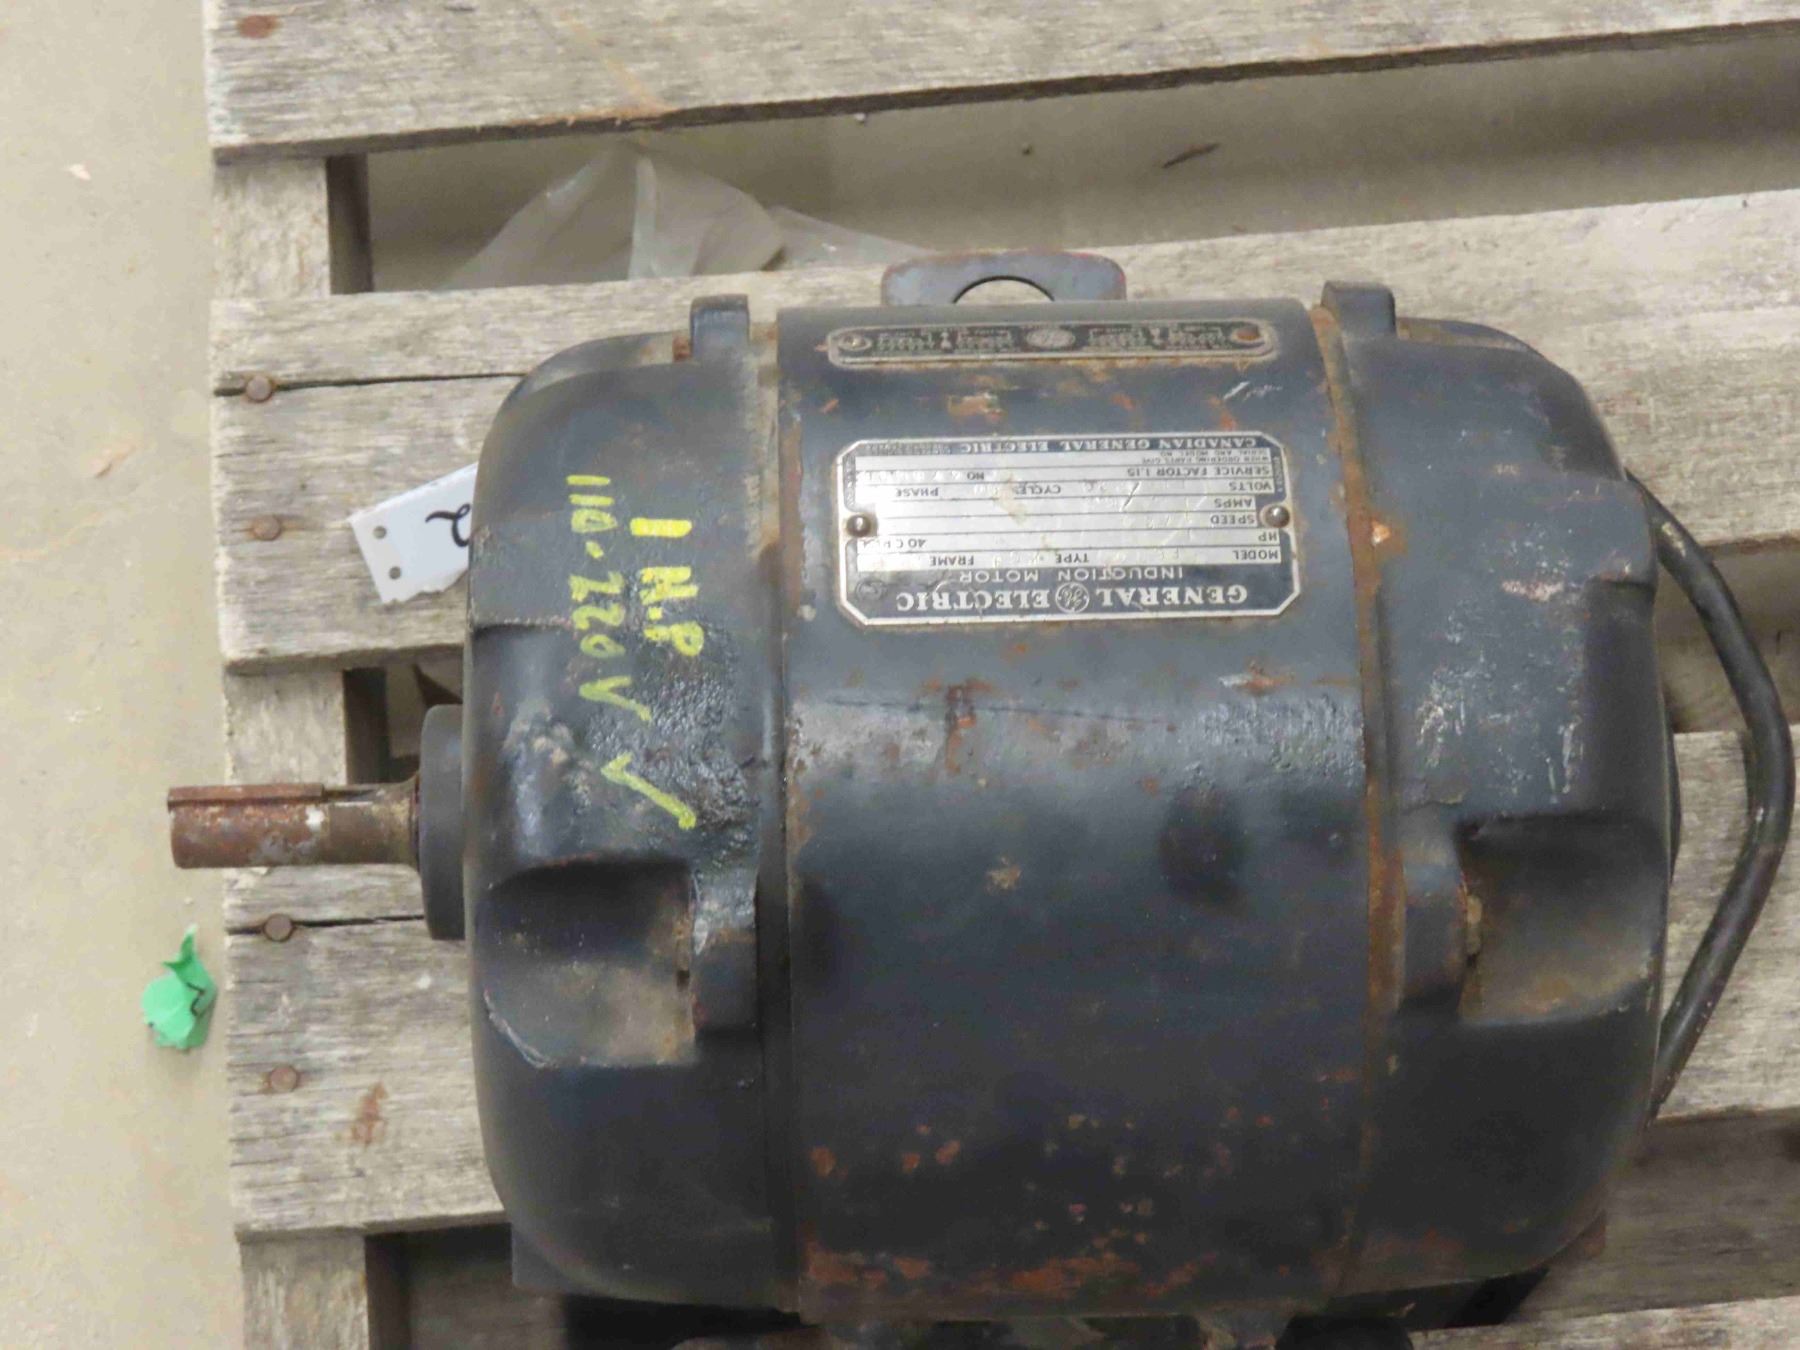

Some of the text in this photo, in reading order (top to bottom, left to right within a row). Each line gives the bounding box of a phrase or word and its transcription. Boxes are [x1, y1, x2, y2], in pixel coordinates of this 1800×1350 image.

[960, 441, 1047, 453] ELECTRIC
[1060, 439, 1150, 451] GENERAL
[1159, 437, 1256, 448] CANADIAN
[967, 472, 984, 480] NO
[1127, 466, 1270, 476] SERVICE FACTOR 1.15
[895, 487, 938, 496] PHASE
[1012, 484, 1061, 495] CYCLES
[1229, 482, 1271, 491] VOLTS
[1214, 498, 1252, 507] AMPS
[1210, 515, 1255, 524] SPEED
[1258, 533, 1278, 541] HP
[908, 538, 926, 548] 40
[1055, 553, 1089, 564] TYPE
[1232, 549, 1278, 560] MODEL
[929, 555, 974, 566] FRAME
[960, 566, 1183, 582] INDUCTION MOTOR
[896, 589, 1050, 611] ELECTRIC
[1096, 585, 1248, 606] GENERAL
